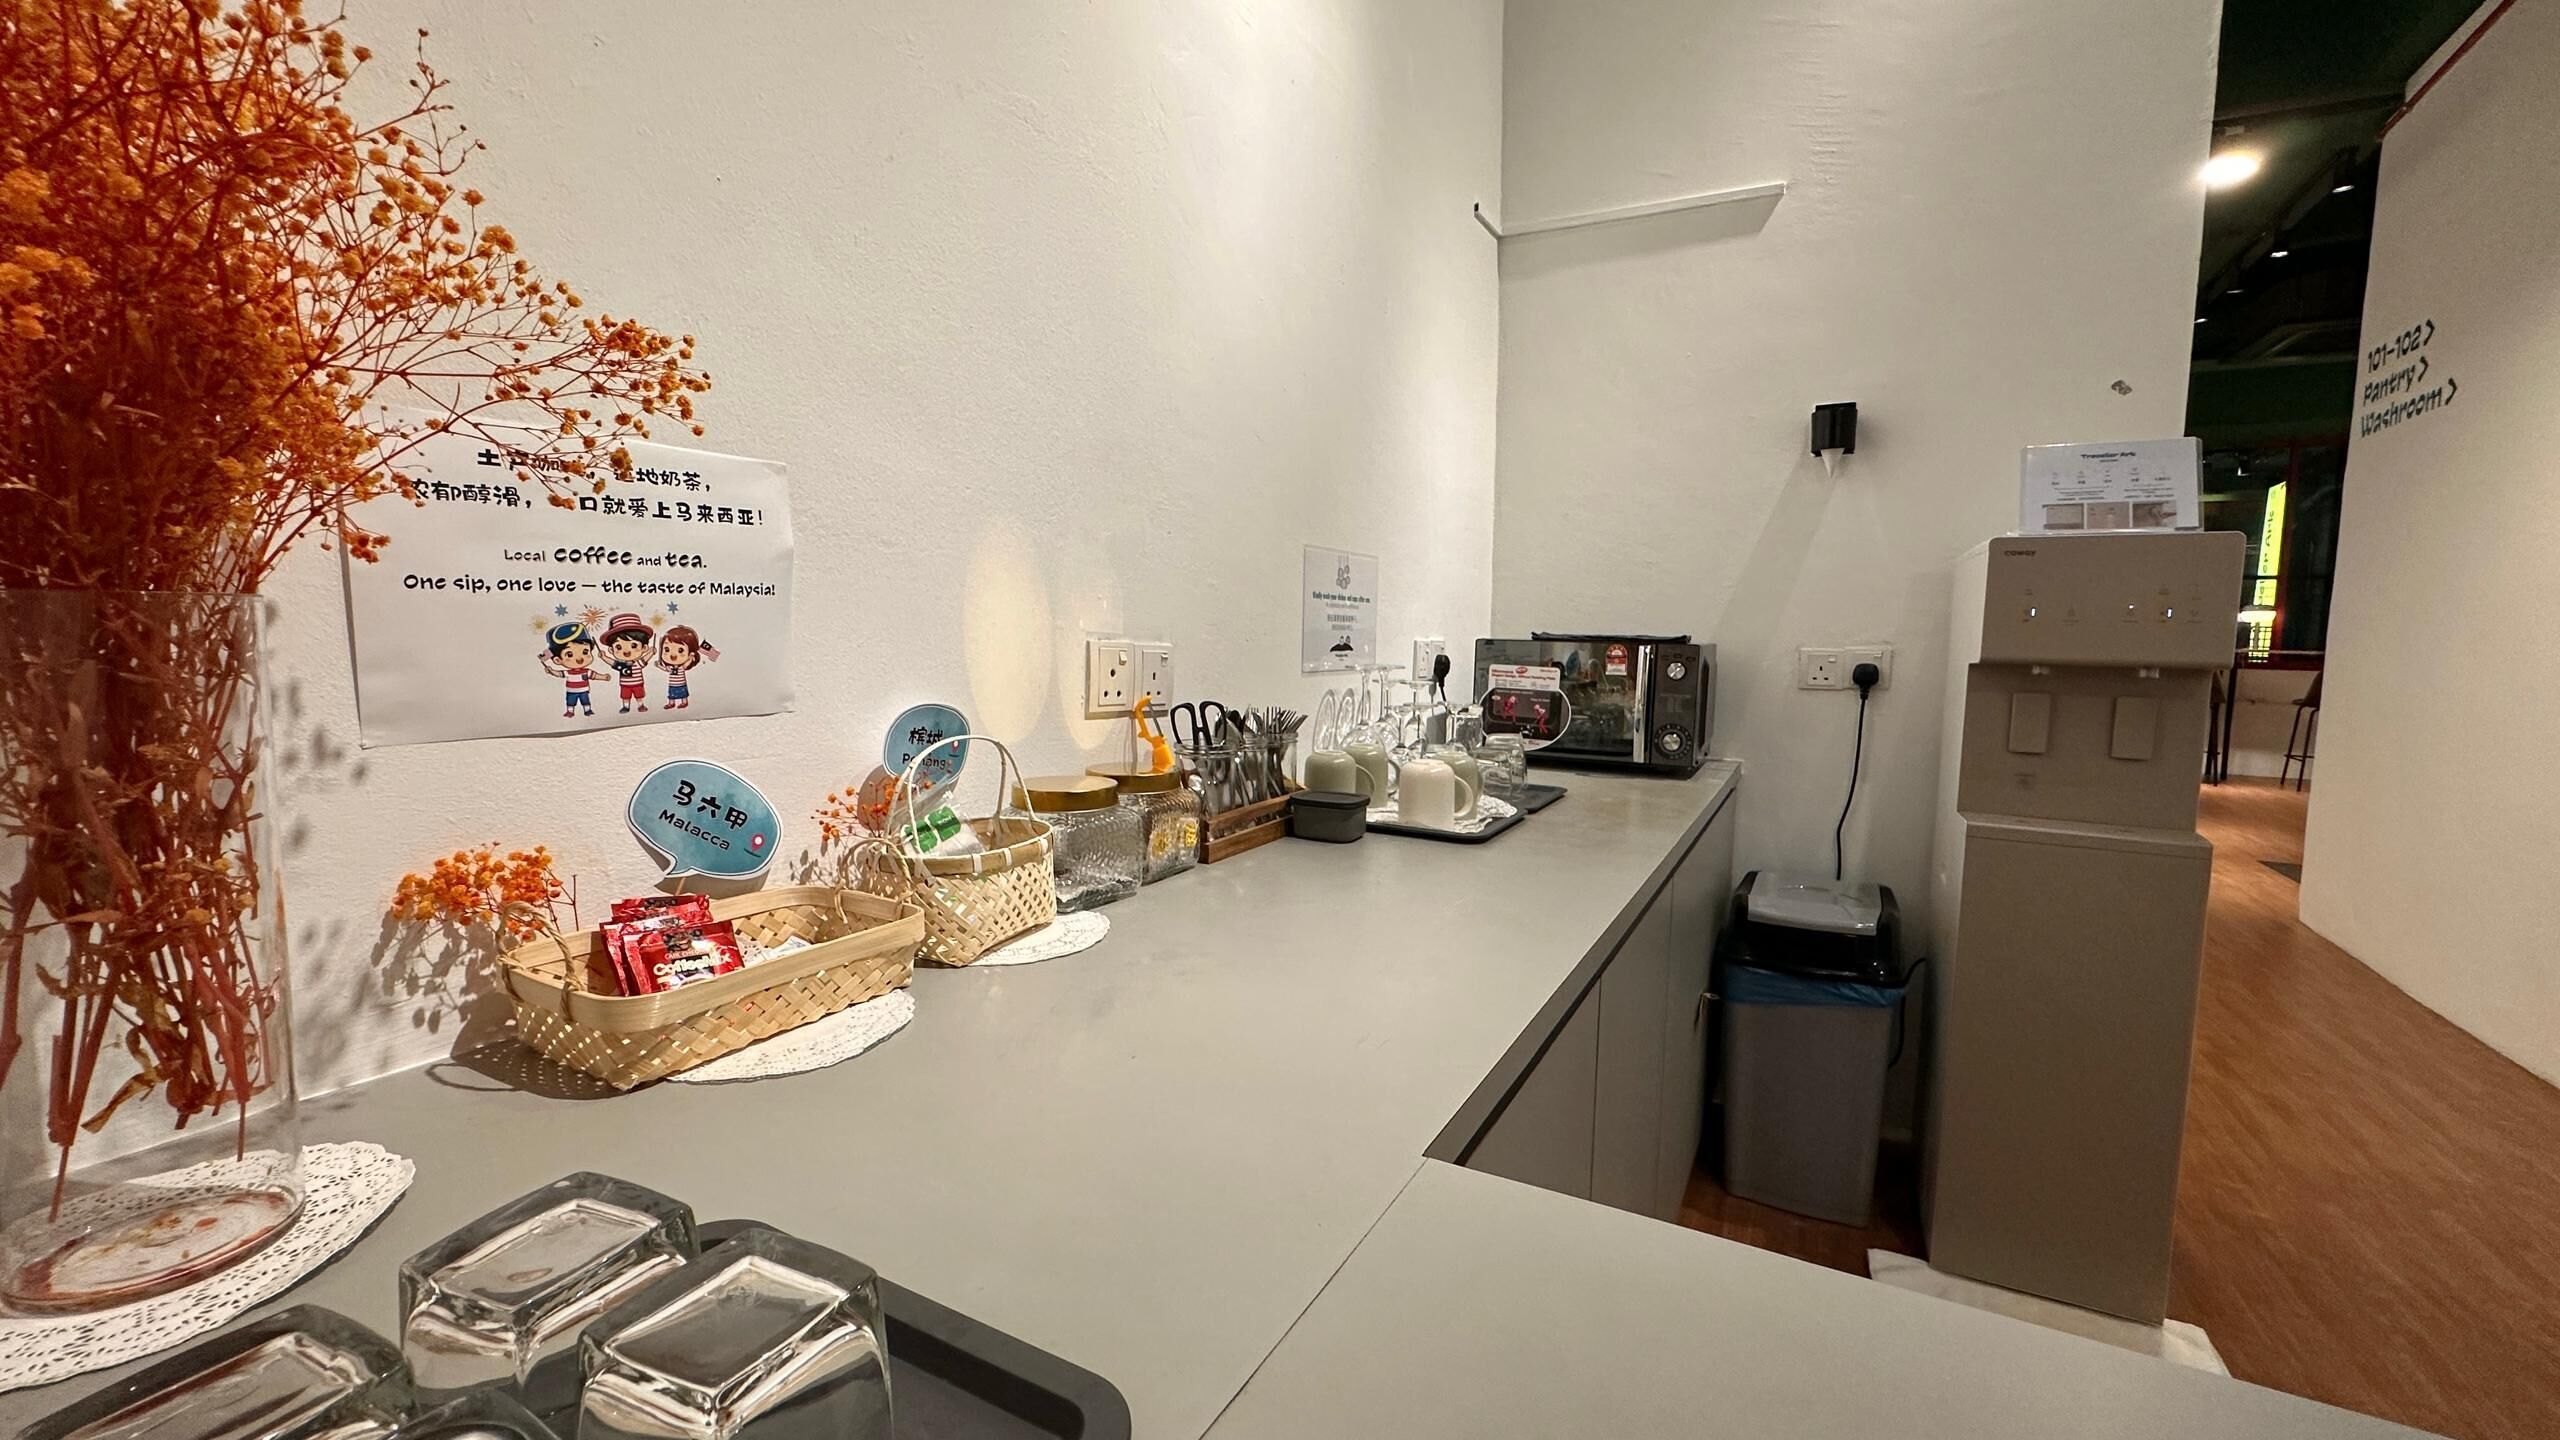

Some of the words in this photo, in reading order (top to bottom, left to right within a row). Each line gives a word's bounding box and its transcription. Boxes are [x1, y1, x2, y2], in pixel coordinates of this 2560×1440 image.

[2368, 324, 2422, 373] 101-102
[2361, 387, 2442, 438] Washroom
[504, 549, 546, 562] Local
[554, 546, 633, 565] coffee
[637, 556, 662, 566] and
[665, 552, 707, 568] tea.
[404, 575, 446, 589] One
[453, 574, 491, 593] sip,
[497, 579, 533, 591] one
[539, 577, 577, 592] love
[601, 579, 633, 593] the
[637, 581, 684, 594] taste
[688, 582, 706, 595] of
[710, 582, 776, 597] Malaysia!
[672, 779, 748, 830] 马六甲
[658, 809, 731, 850] Malacca
